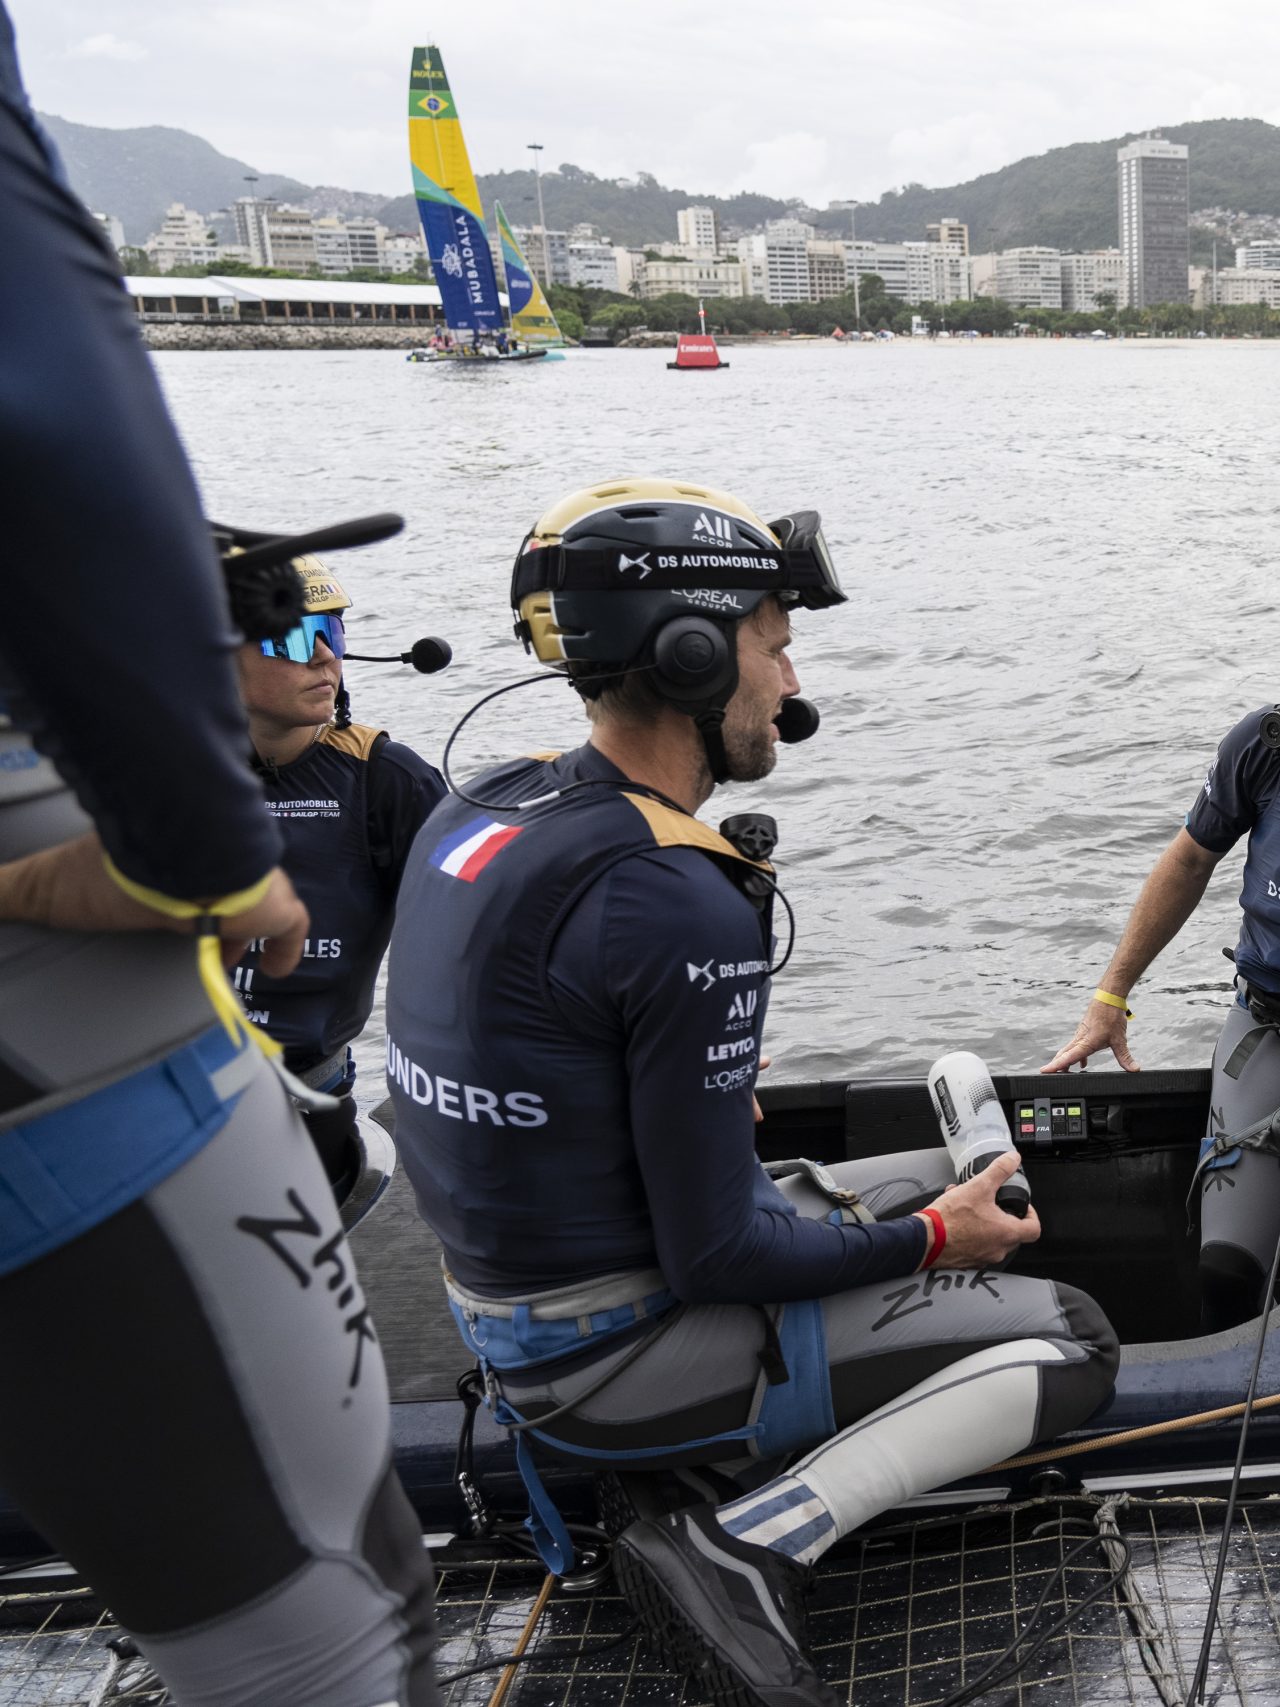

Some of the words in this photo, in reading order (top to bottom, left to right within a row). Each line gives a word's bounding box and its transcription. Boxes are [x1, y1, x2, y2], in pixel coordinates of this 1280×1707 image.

[456, 216, 483, 304] MUBADALA
[692, 533, 733, 549] ACCOR
[658, 555, 678, 568] DS
[681, 555, 779, 570] AUTOMOBILES
[687, 598, 727, 612] GROUPE
[278, 799, 339, 809] AUTOMOBILES
[719, 963, 735, 978] DS
[725, 1020, 752, 1031] ACCO
[707, 1036, 755, 1062] LEYTO
[871, 1269, 1000, 1332] Zhik
